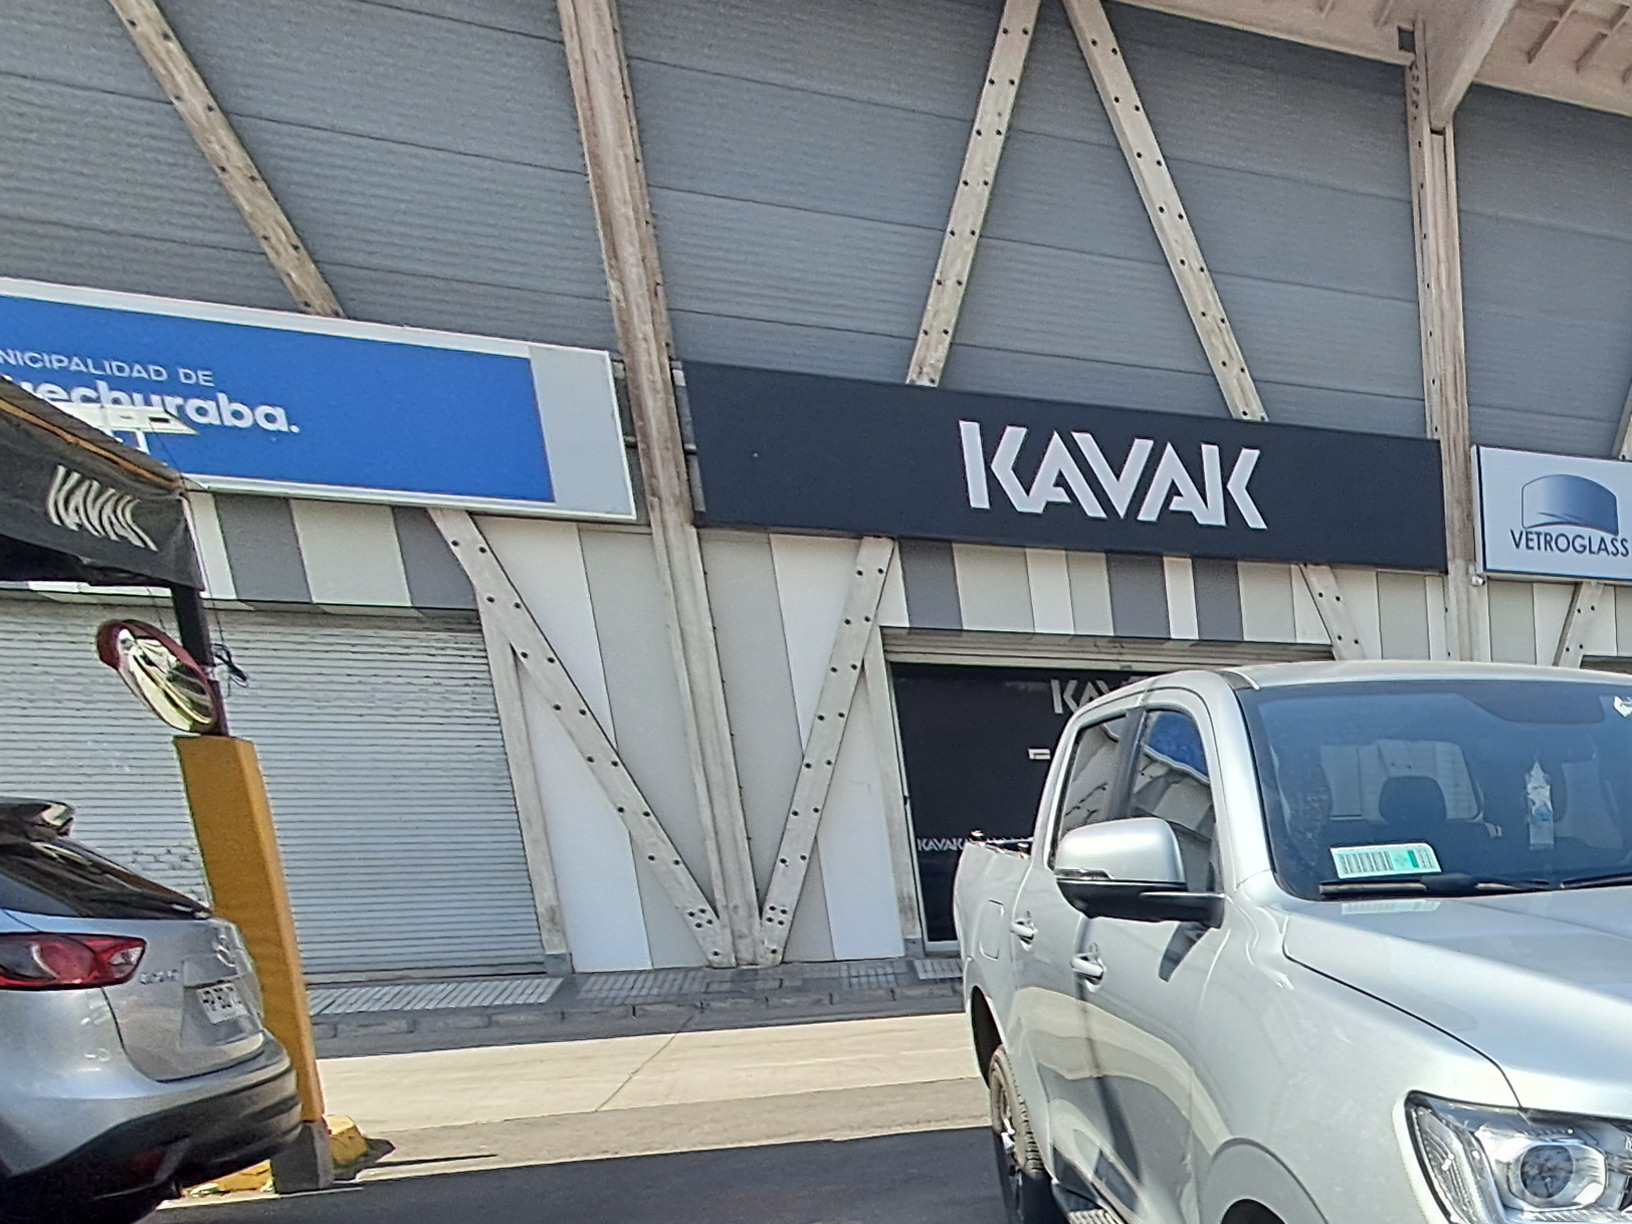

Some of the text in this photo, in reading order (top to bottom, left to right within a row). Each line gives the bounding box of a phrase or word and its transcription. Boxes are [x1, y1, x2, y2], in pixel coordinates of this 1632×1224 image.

[178, 367, 216, 387] DE
[959, 420, 1268, 530] KAVAK
[1510, 528, 1630, 557] VETROGLASS
